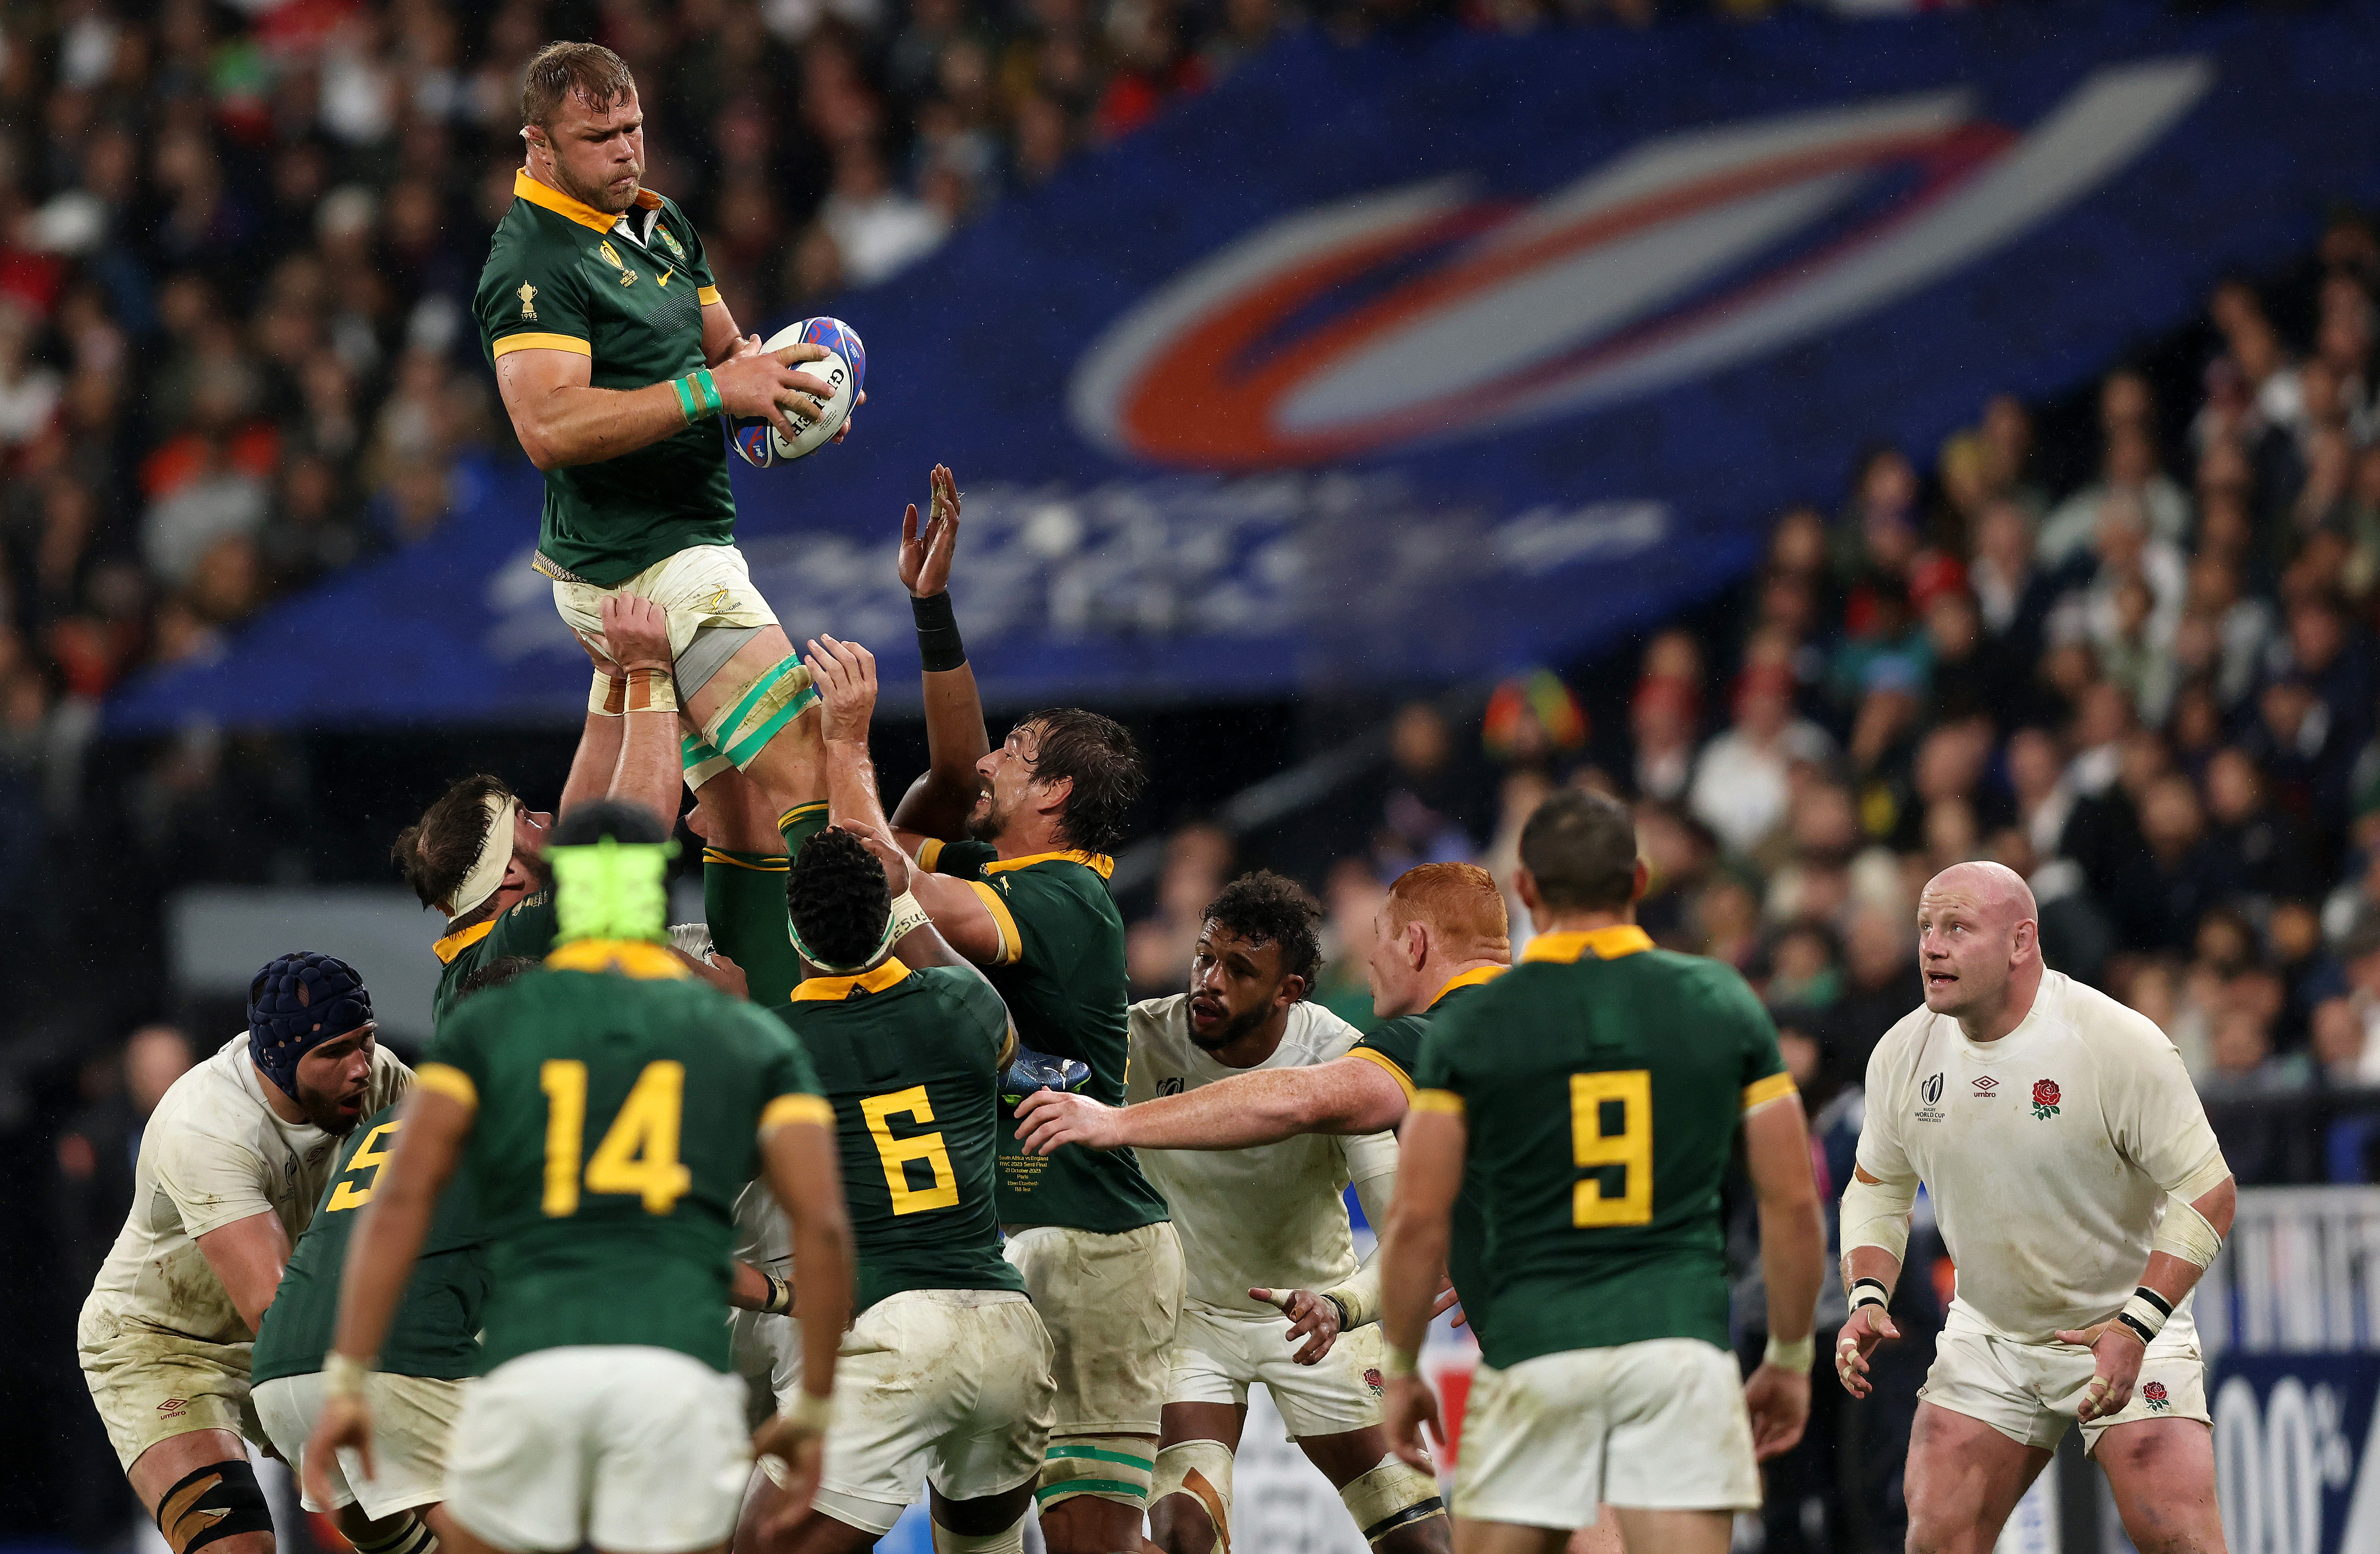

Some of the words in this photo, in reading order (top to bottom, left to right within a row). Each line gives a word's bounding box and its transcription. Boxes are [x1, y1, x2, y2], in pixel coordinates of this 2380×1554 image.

[620, 273, 632, 285] WORLD
[778, 369, 844, 447] GERT
[715, 601, 742, 614] SPNGBOK
[891, 910, 928, 943] ESUS
[326, 1119, 403, 1212] 5
[541, 1059, 691, 1217] 14
[860, 1085, 959, 1215] 6
[1570, 1069, 1654, 1227] 9
[161, 1411, 186, 1420] umbro
